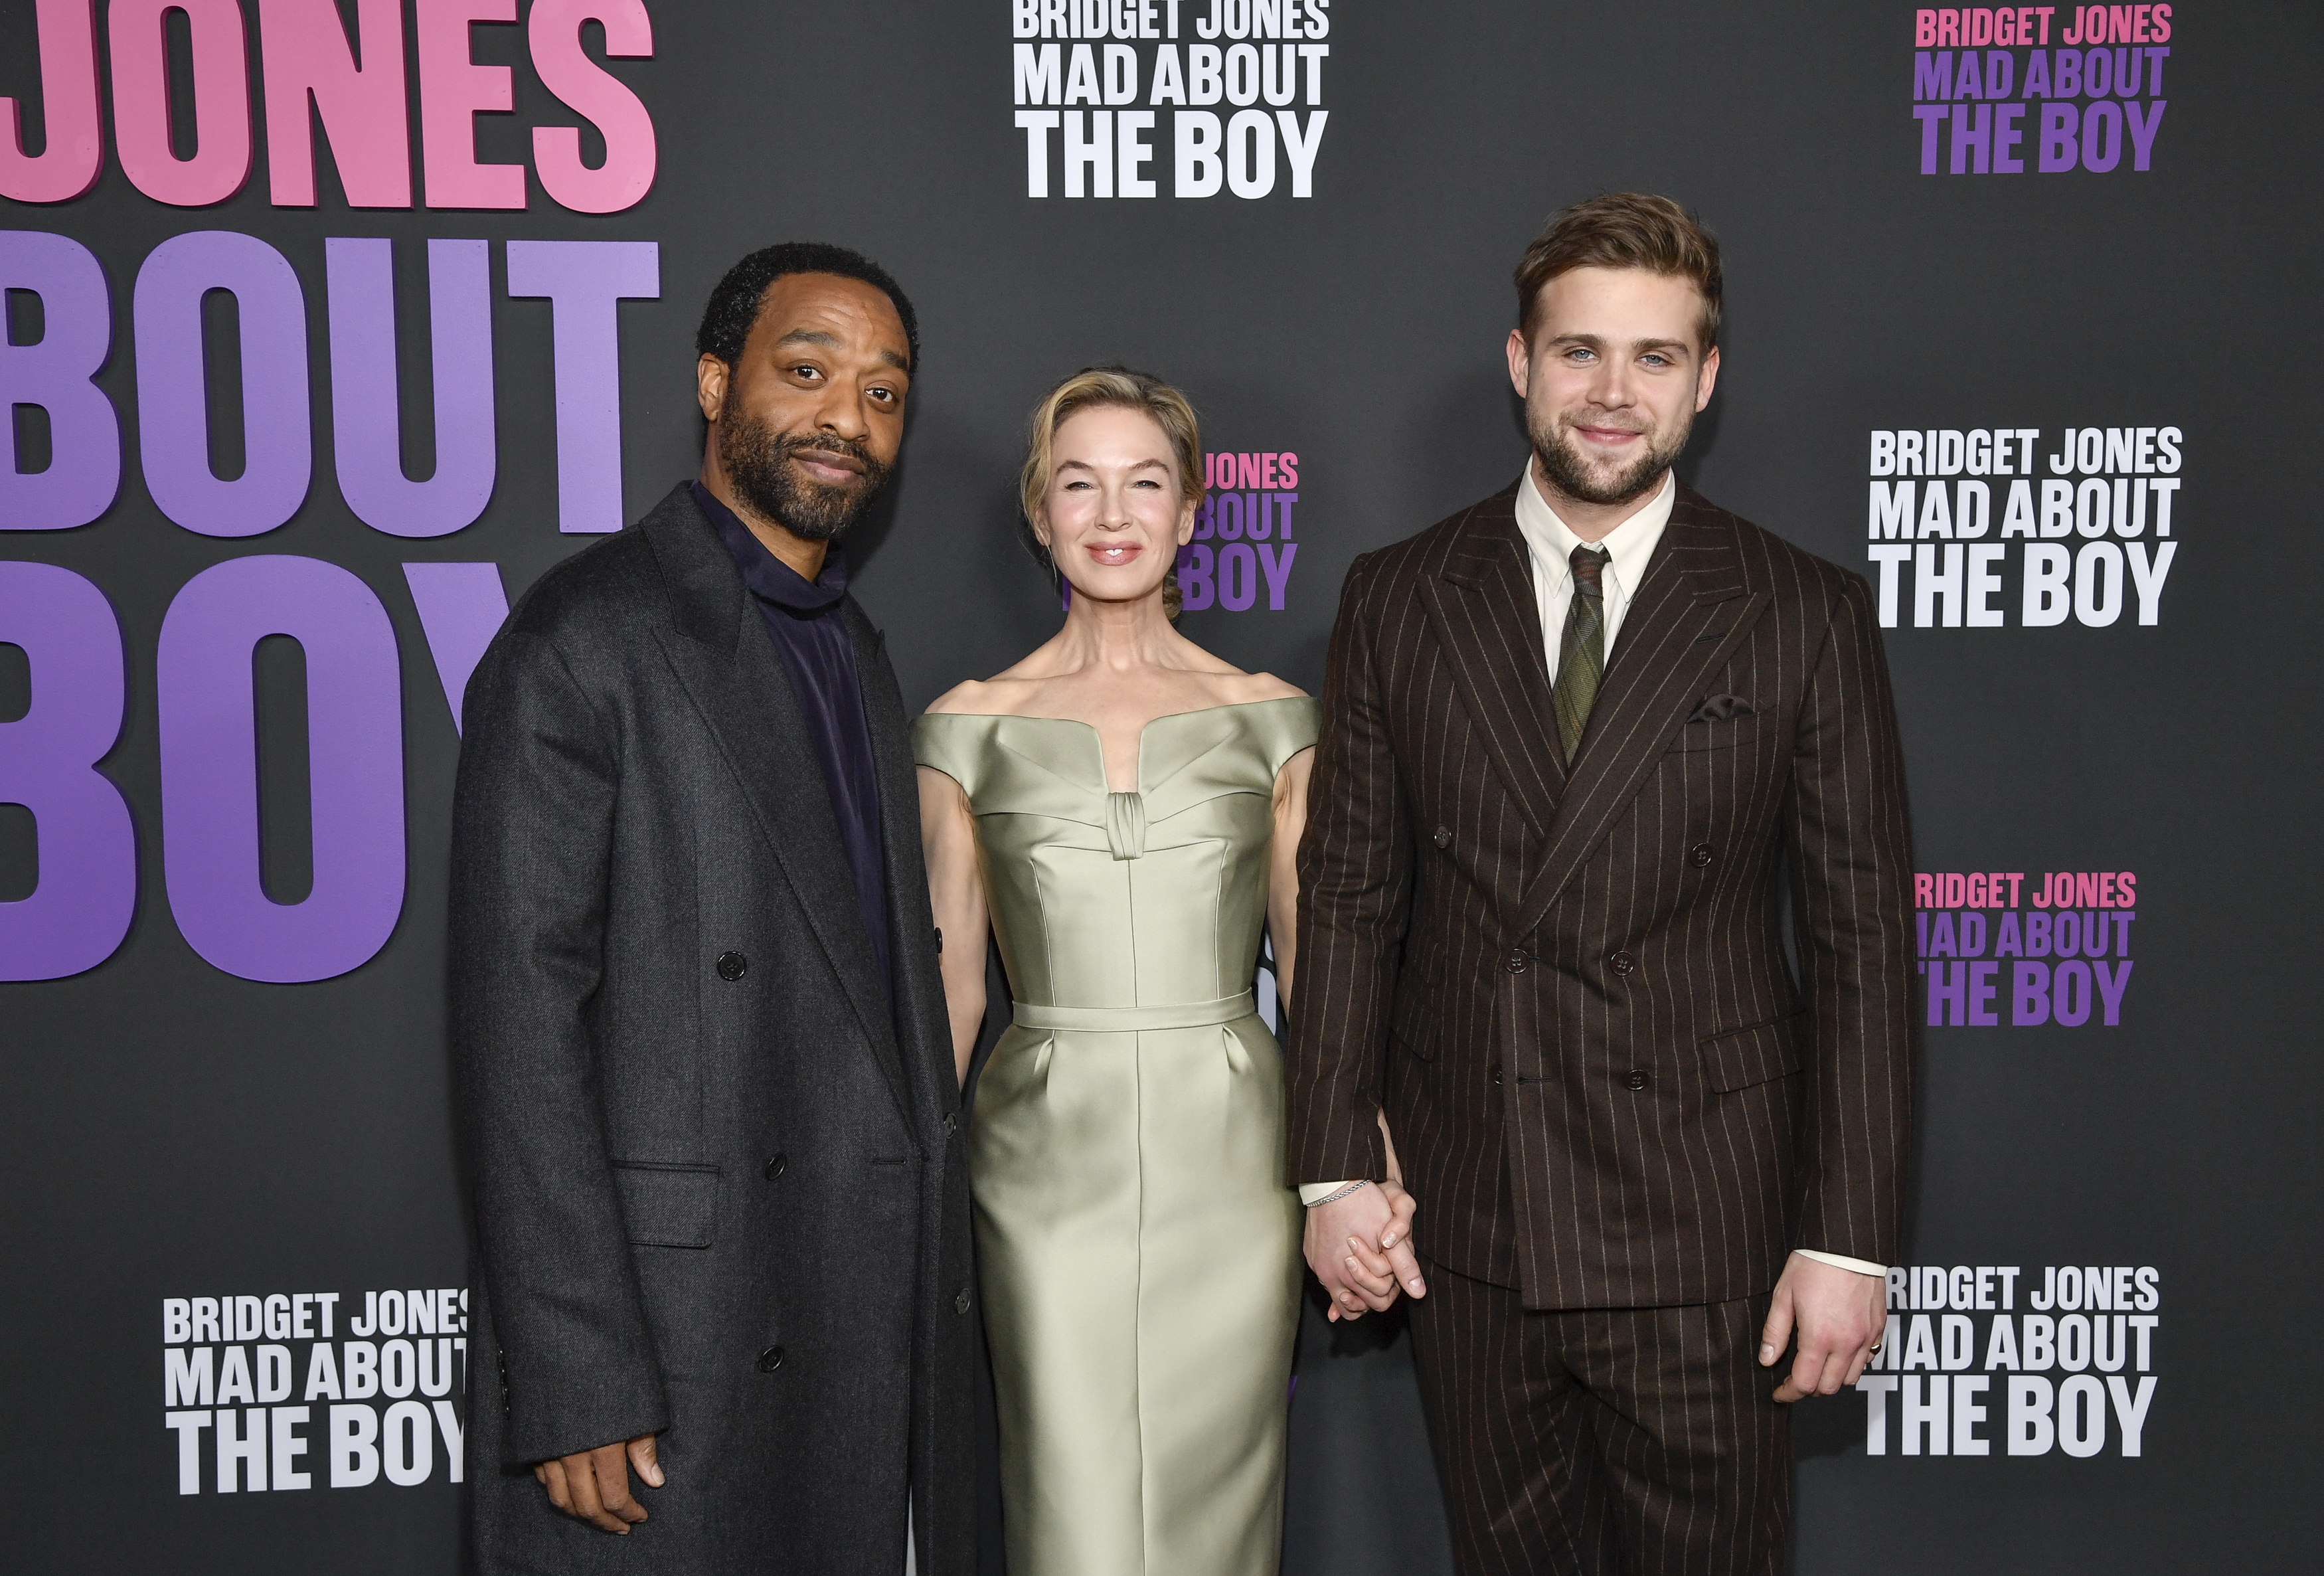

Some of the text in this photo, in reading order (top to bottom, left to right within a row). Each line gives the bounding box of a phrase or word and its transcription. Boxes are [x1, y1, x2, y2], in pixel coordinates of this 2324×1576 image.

[1012, 0, 1330, 40] BRIDGET JONES
[1915, 3, 2173, 48] BRIDGET JONES
[1013, 43, 1329, 107] MAD ABOUT
[1913, 46, 2171, 101] MAD ABOUT
[0, 0, 657, 214] JONES
[1912, 100, 2167, 175] THE BOY
[1014, 109, 1329, 199] THE BOY
[0, 229, 660, 538] BOUT
[1870, 426, 2183, 476] BRIDGET JONES
[1193, 492, 1299, 541] BOUT
[1869, 477, 2181, 540] MAD ABOUT
[1177, 543, 1298, 612] BOY
[1868, 541, 2178, 628] THE BOY
[1914, 871, 2137, 909] RIDGET JONES
[1995, 911, 2135, 958] ABOUT
[1918, 959, 2134, 1027] HE BOY
[163, 1292, 339, 1344] BRIDGET
[1886, 1265, 2159, 1312] RIDGET JONES
[1984, 1314, 2159, 1372] ABOUT
[164, 1344, 291, 1407] MAD
[1857, 1374, 2158, 1458] THE BOY
[165, 1406, 311, 1496] THE
